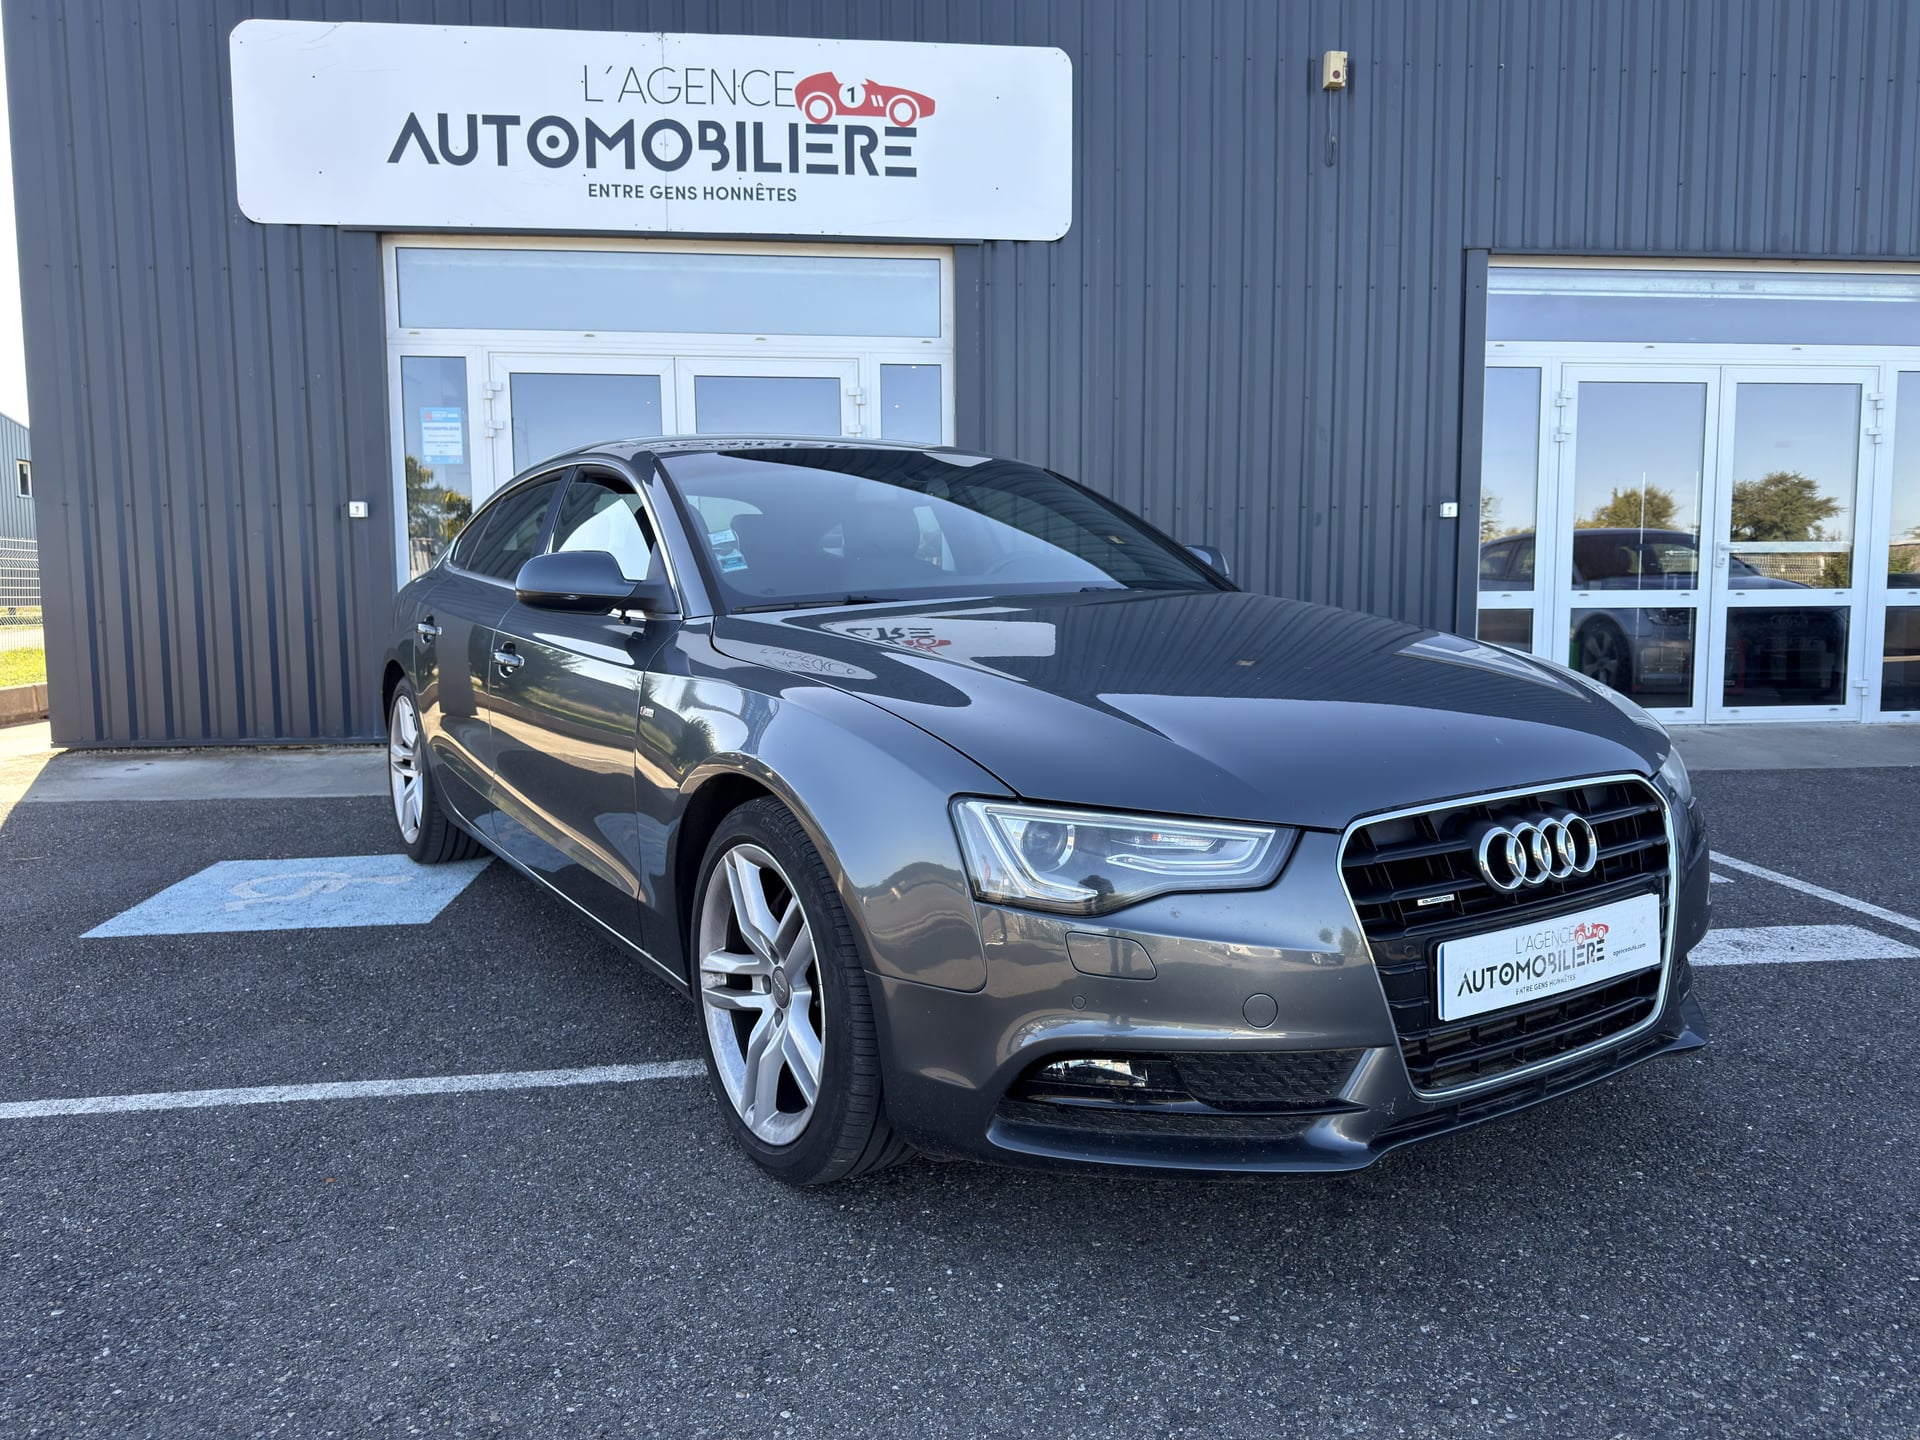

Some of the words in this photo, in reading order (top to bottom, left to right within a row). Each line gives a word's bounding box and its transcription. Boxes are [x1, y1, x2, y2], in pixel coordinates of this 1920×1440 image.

[584, 65, 796, 107] L'AGENCE
[846, 86, 856, 103] 1
[588, 183, 644, 199] ENTRE
[650, 185, 698, 200] GENS
[703, 183, 797, 202] HONNÊTES
[1515, 925, 1575, 955] L'AGENCE
[1516, 982, 1533, 995] ENTRE
[1534, 980, 1548, 991] GENS
